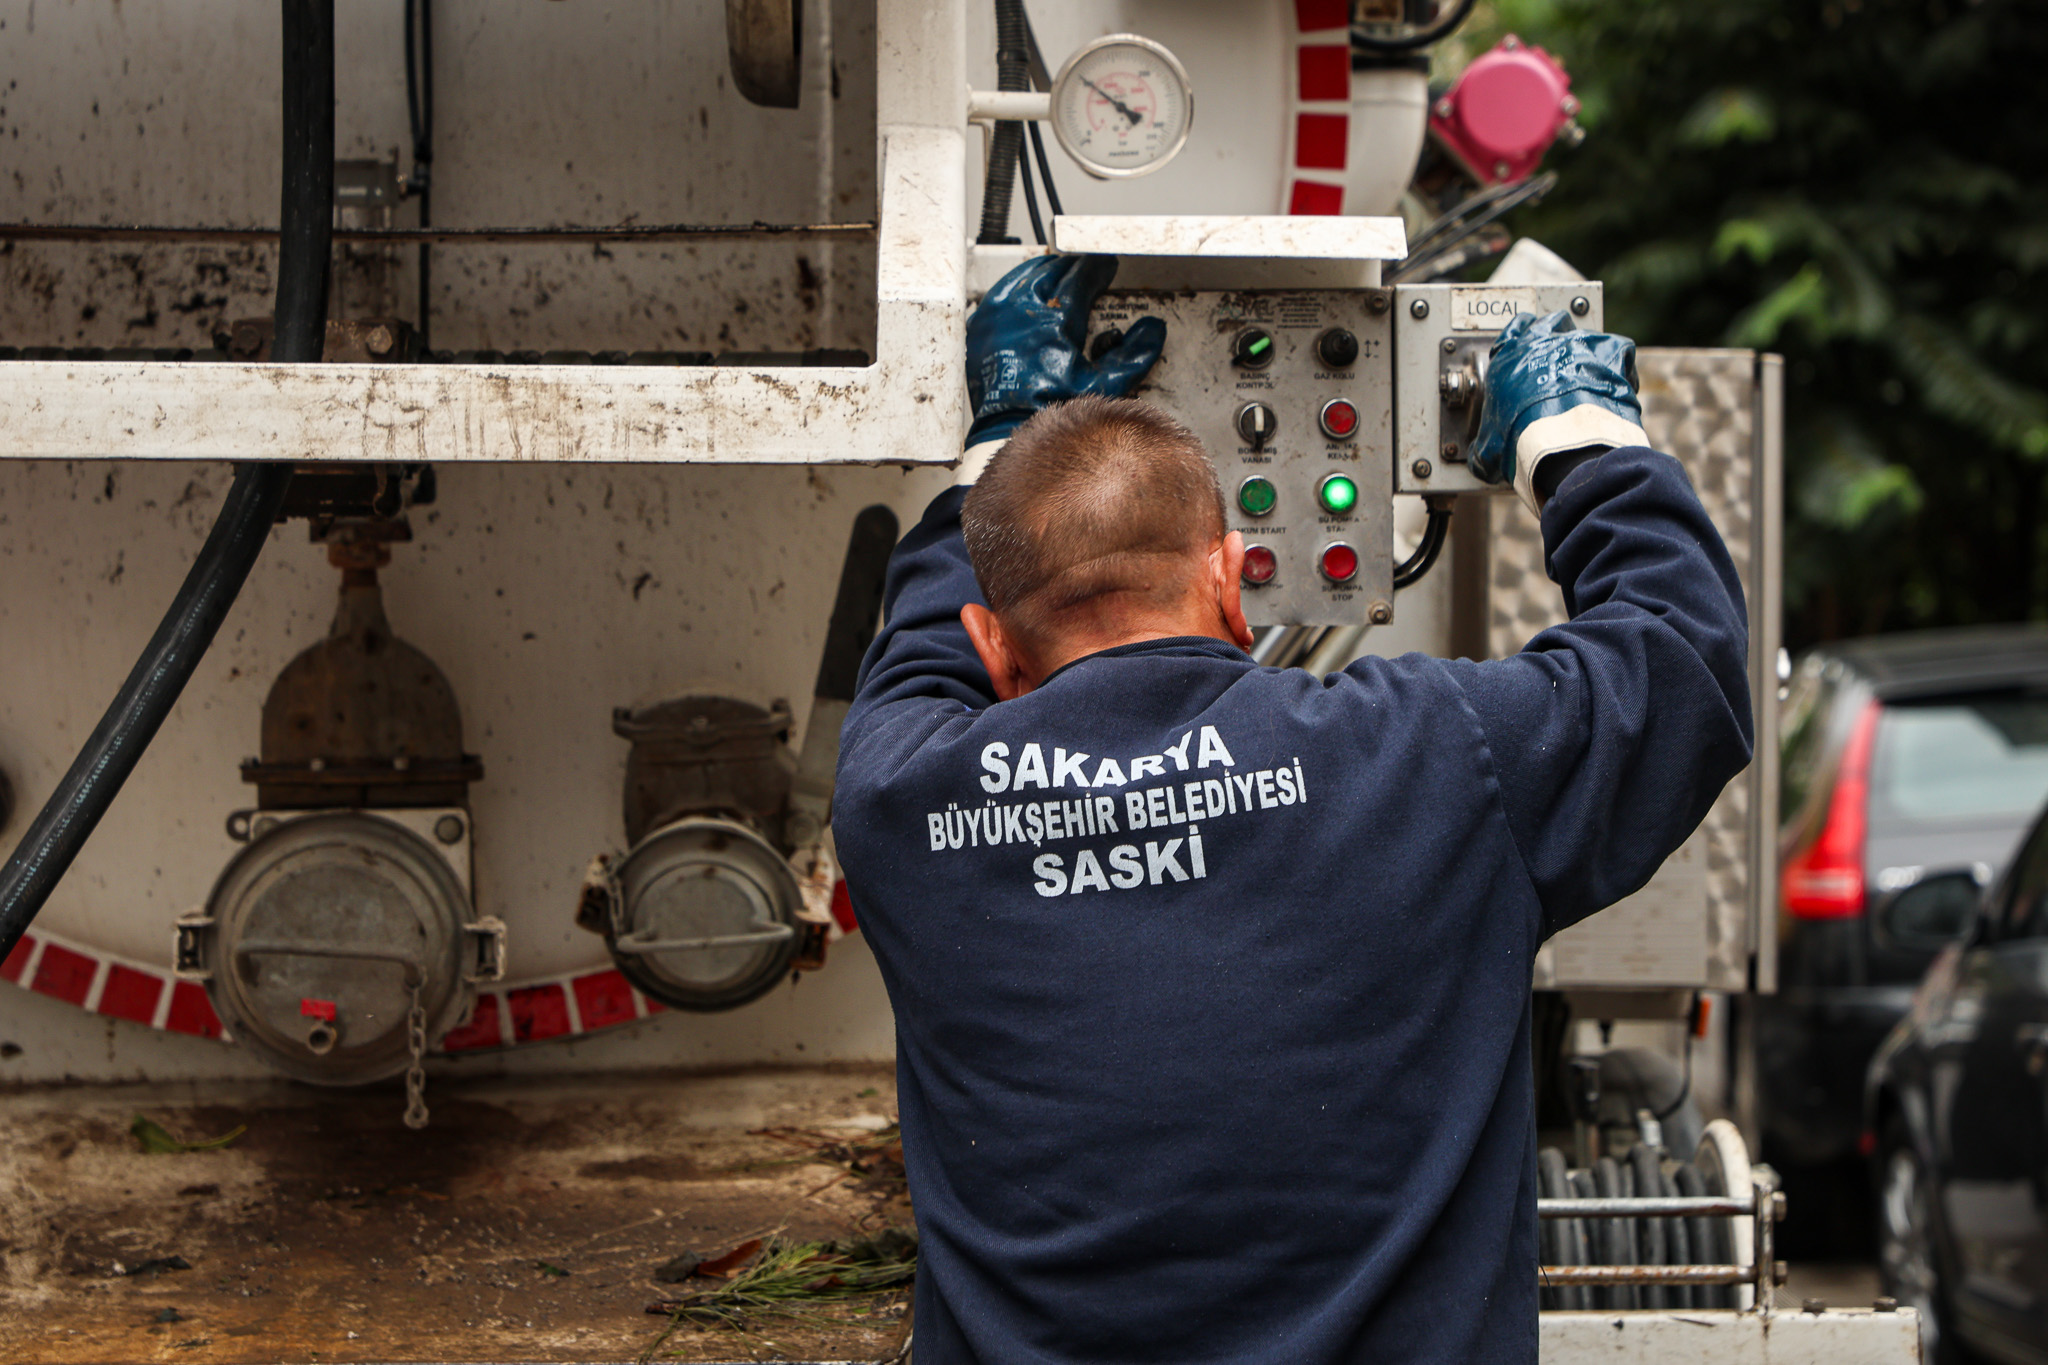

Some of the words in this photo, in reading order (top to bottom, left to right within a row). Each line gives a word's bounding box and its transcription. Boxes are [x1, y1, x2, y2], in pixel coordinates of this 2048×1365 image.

[1332, 593, 1353, 602] STOP
[980, 725, 1234, 794] SAKARYA
[927, 792, 1119, 851] BÜYÜKŞEHİR
[1126, 757, 1307, 830] BELEDİYESİ
[1033, 825, 1206, 898] SASKİ
